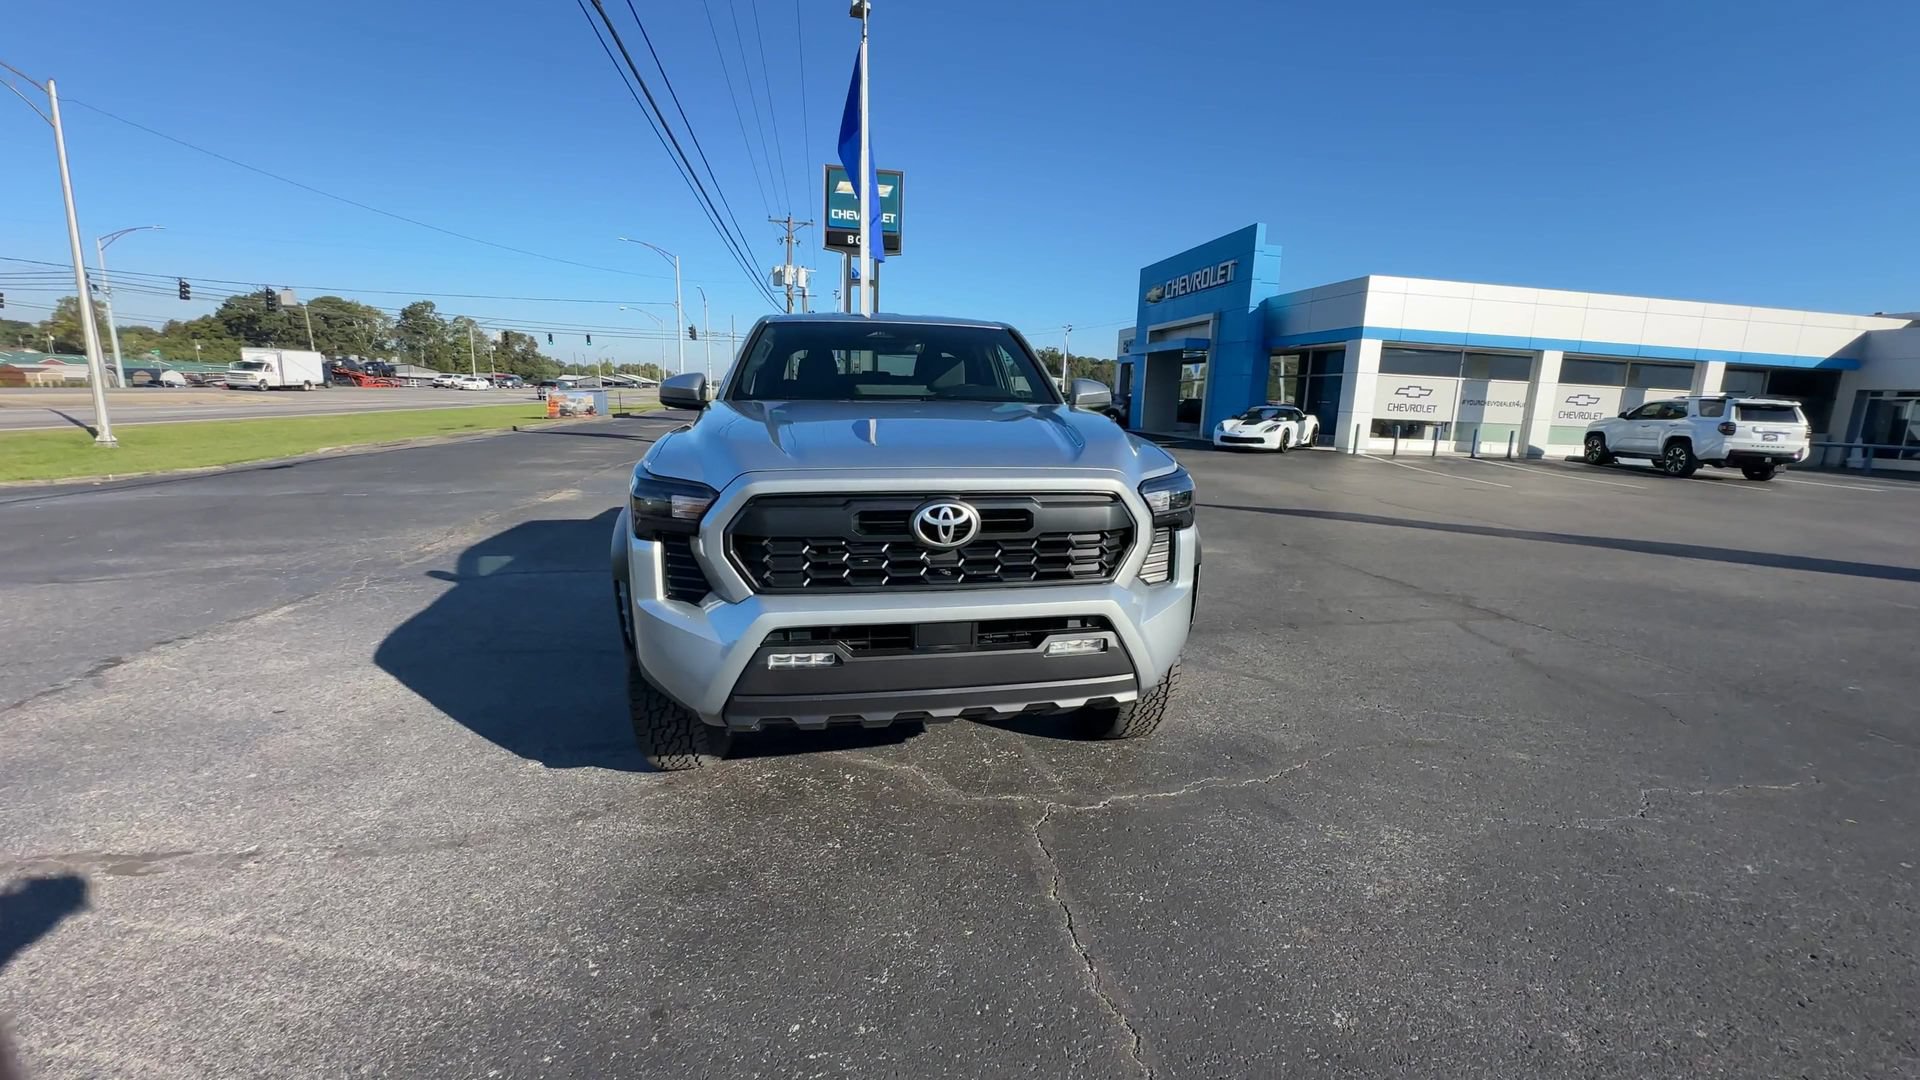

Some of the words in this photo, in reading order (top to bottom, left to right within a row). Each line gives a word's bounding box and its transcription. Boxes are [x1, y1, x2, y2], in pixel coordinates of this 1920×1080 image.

[831, 208, 896, 223] CHEVET
[1164, 259, 1237, 299] CHEVROLET
[1387, 402, 1437, 413] CHEVROLET
[1558, 410, 1604, 421] CHEVROLET
